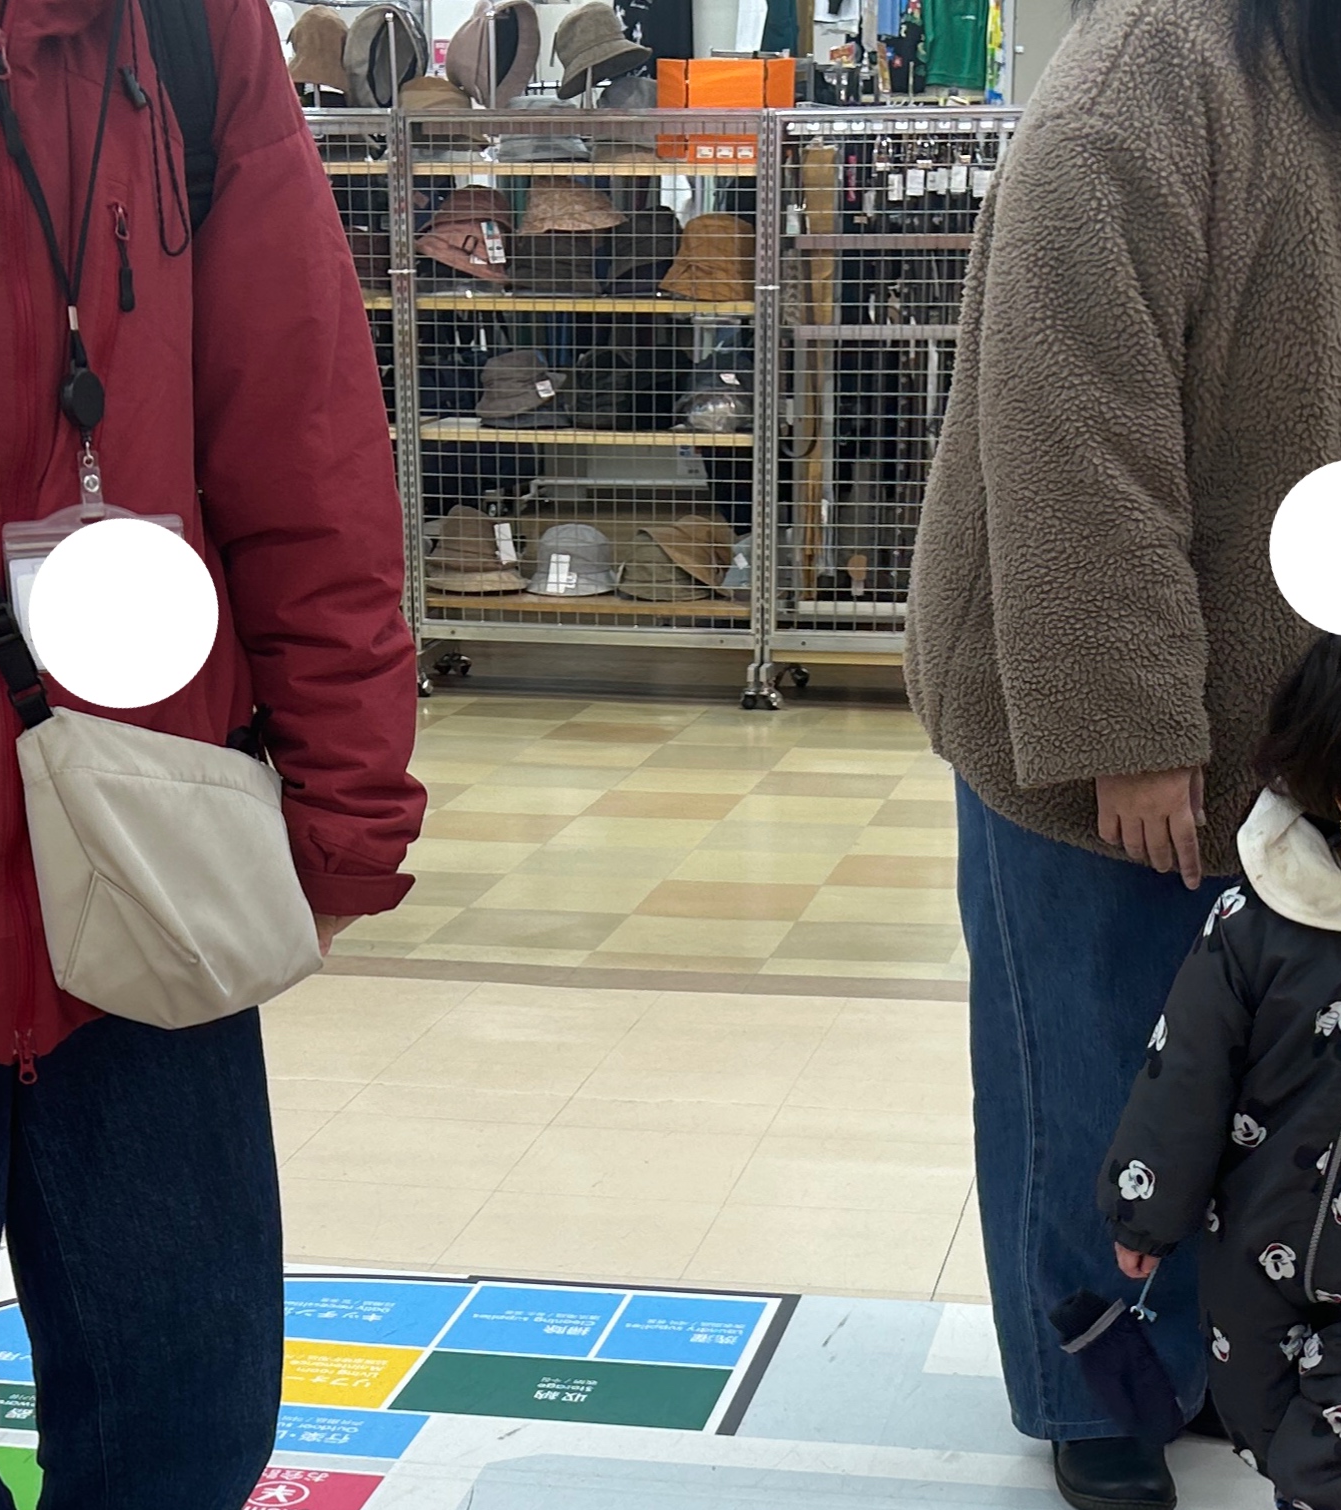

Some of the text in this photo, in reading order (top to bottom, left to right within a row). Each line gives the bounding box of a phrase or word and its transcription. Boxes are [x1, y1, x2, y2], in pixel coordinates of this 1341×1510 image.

[533, 1316, 594, 1326] Cleaning
[282, 1375, 370, 1387] リフォー
[537, 1382, 592, 1391] Storage
[534, 1390, 586, 1401] 収納
[276, 1429, 349, 1443] 行楽・レ
